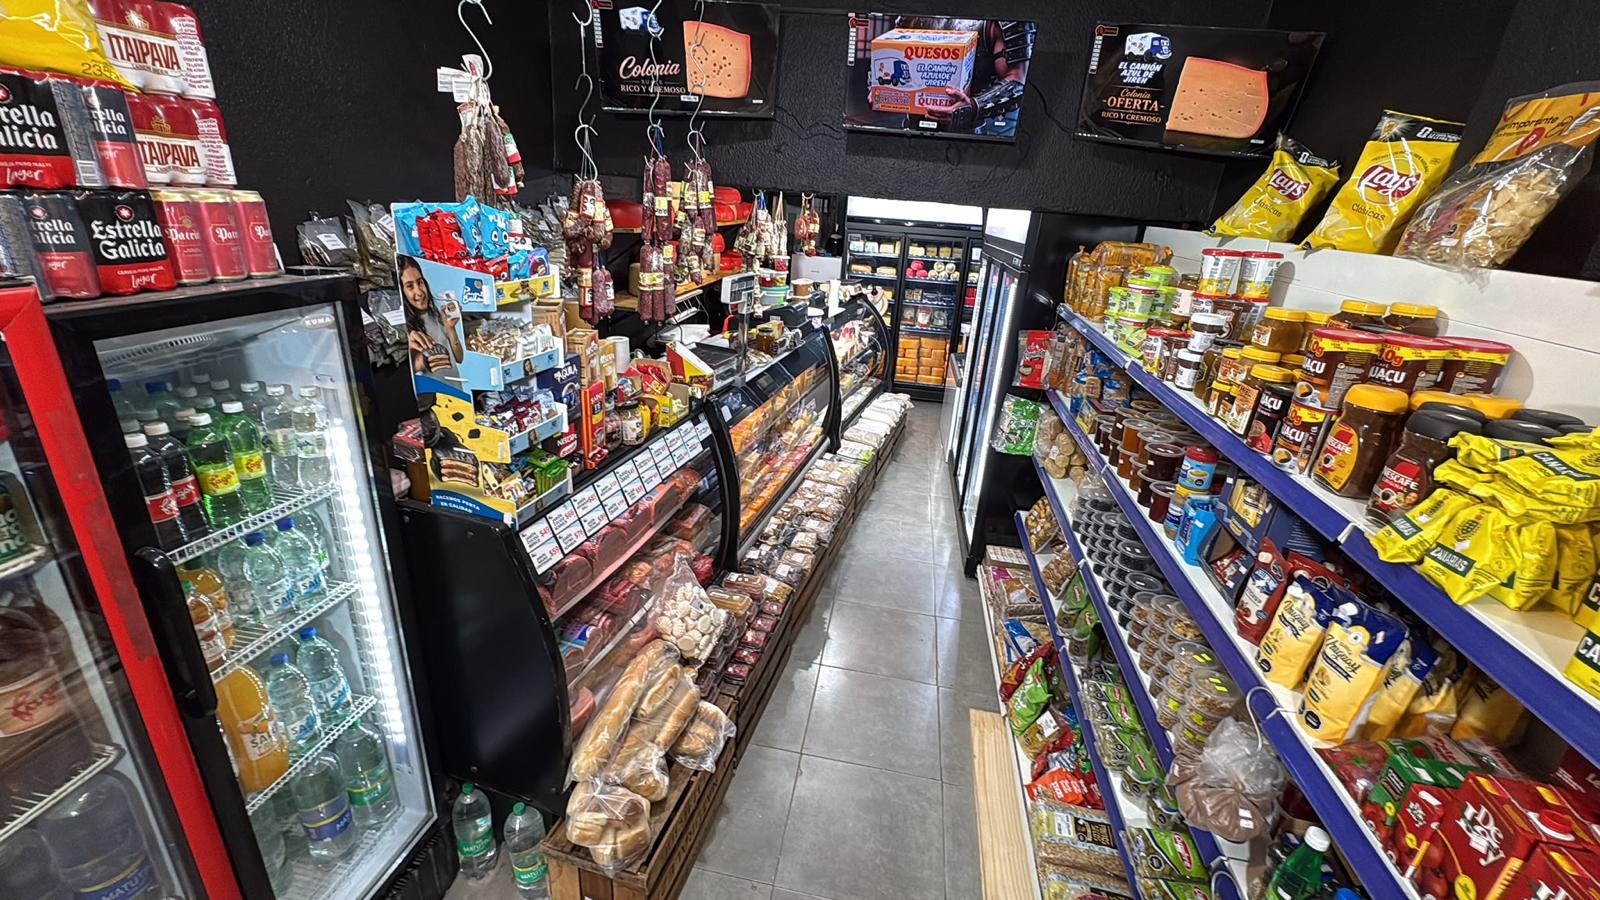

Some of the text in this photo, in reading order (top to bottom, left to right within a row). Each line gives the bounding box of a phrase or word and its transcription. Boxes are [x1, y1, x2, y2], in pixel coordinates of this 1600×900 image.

[106, 33, 181, 71] ITAIPAVA
[904, 47, 960, 60] QUESOS
[619, 55, 680, 80] Colonia
[1118, 61, 1162, 72] EL CAMIÓN
[1120, 70, 1144, 78] AZUL
[1123, 76, 1148, 84] JIREN
[1120, 88, 1151, 99] Colonia
[1101, 111, 1119, 119] RICO
[1125, 113, 1161, 124] CREMOSO
[91, 219, 162, 240] Estrella
[100, 236, 166, 260] Galicia
